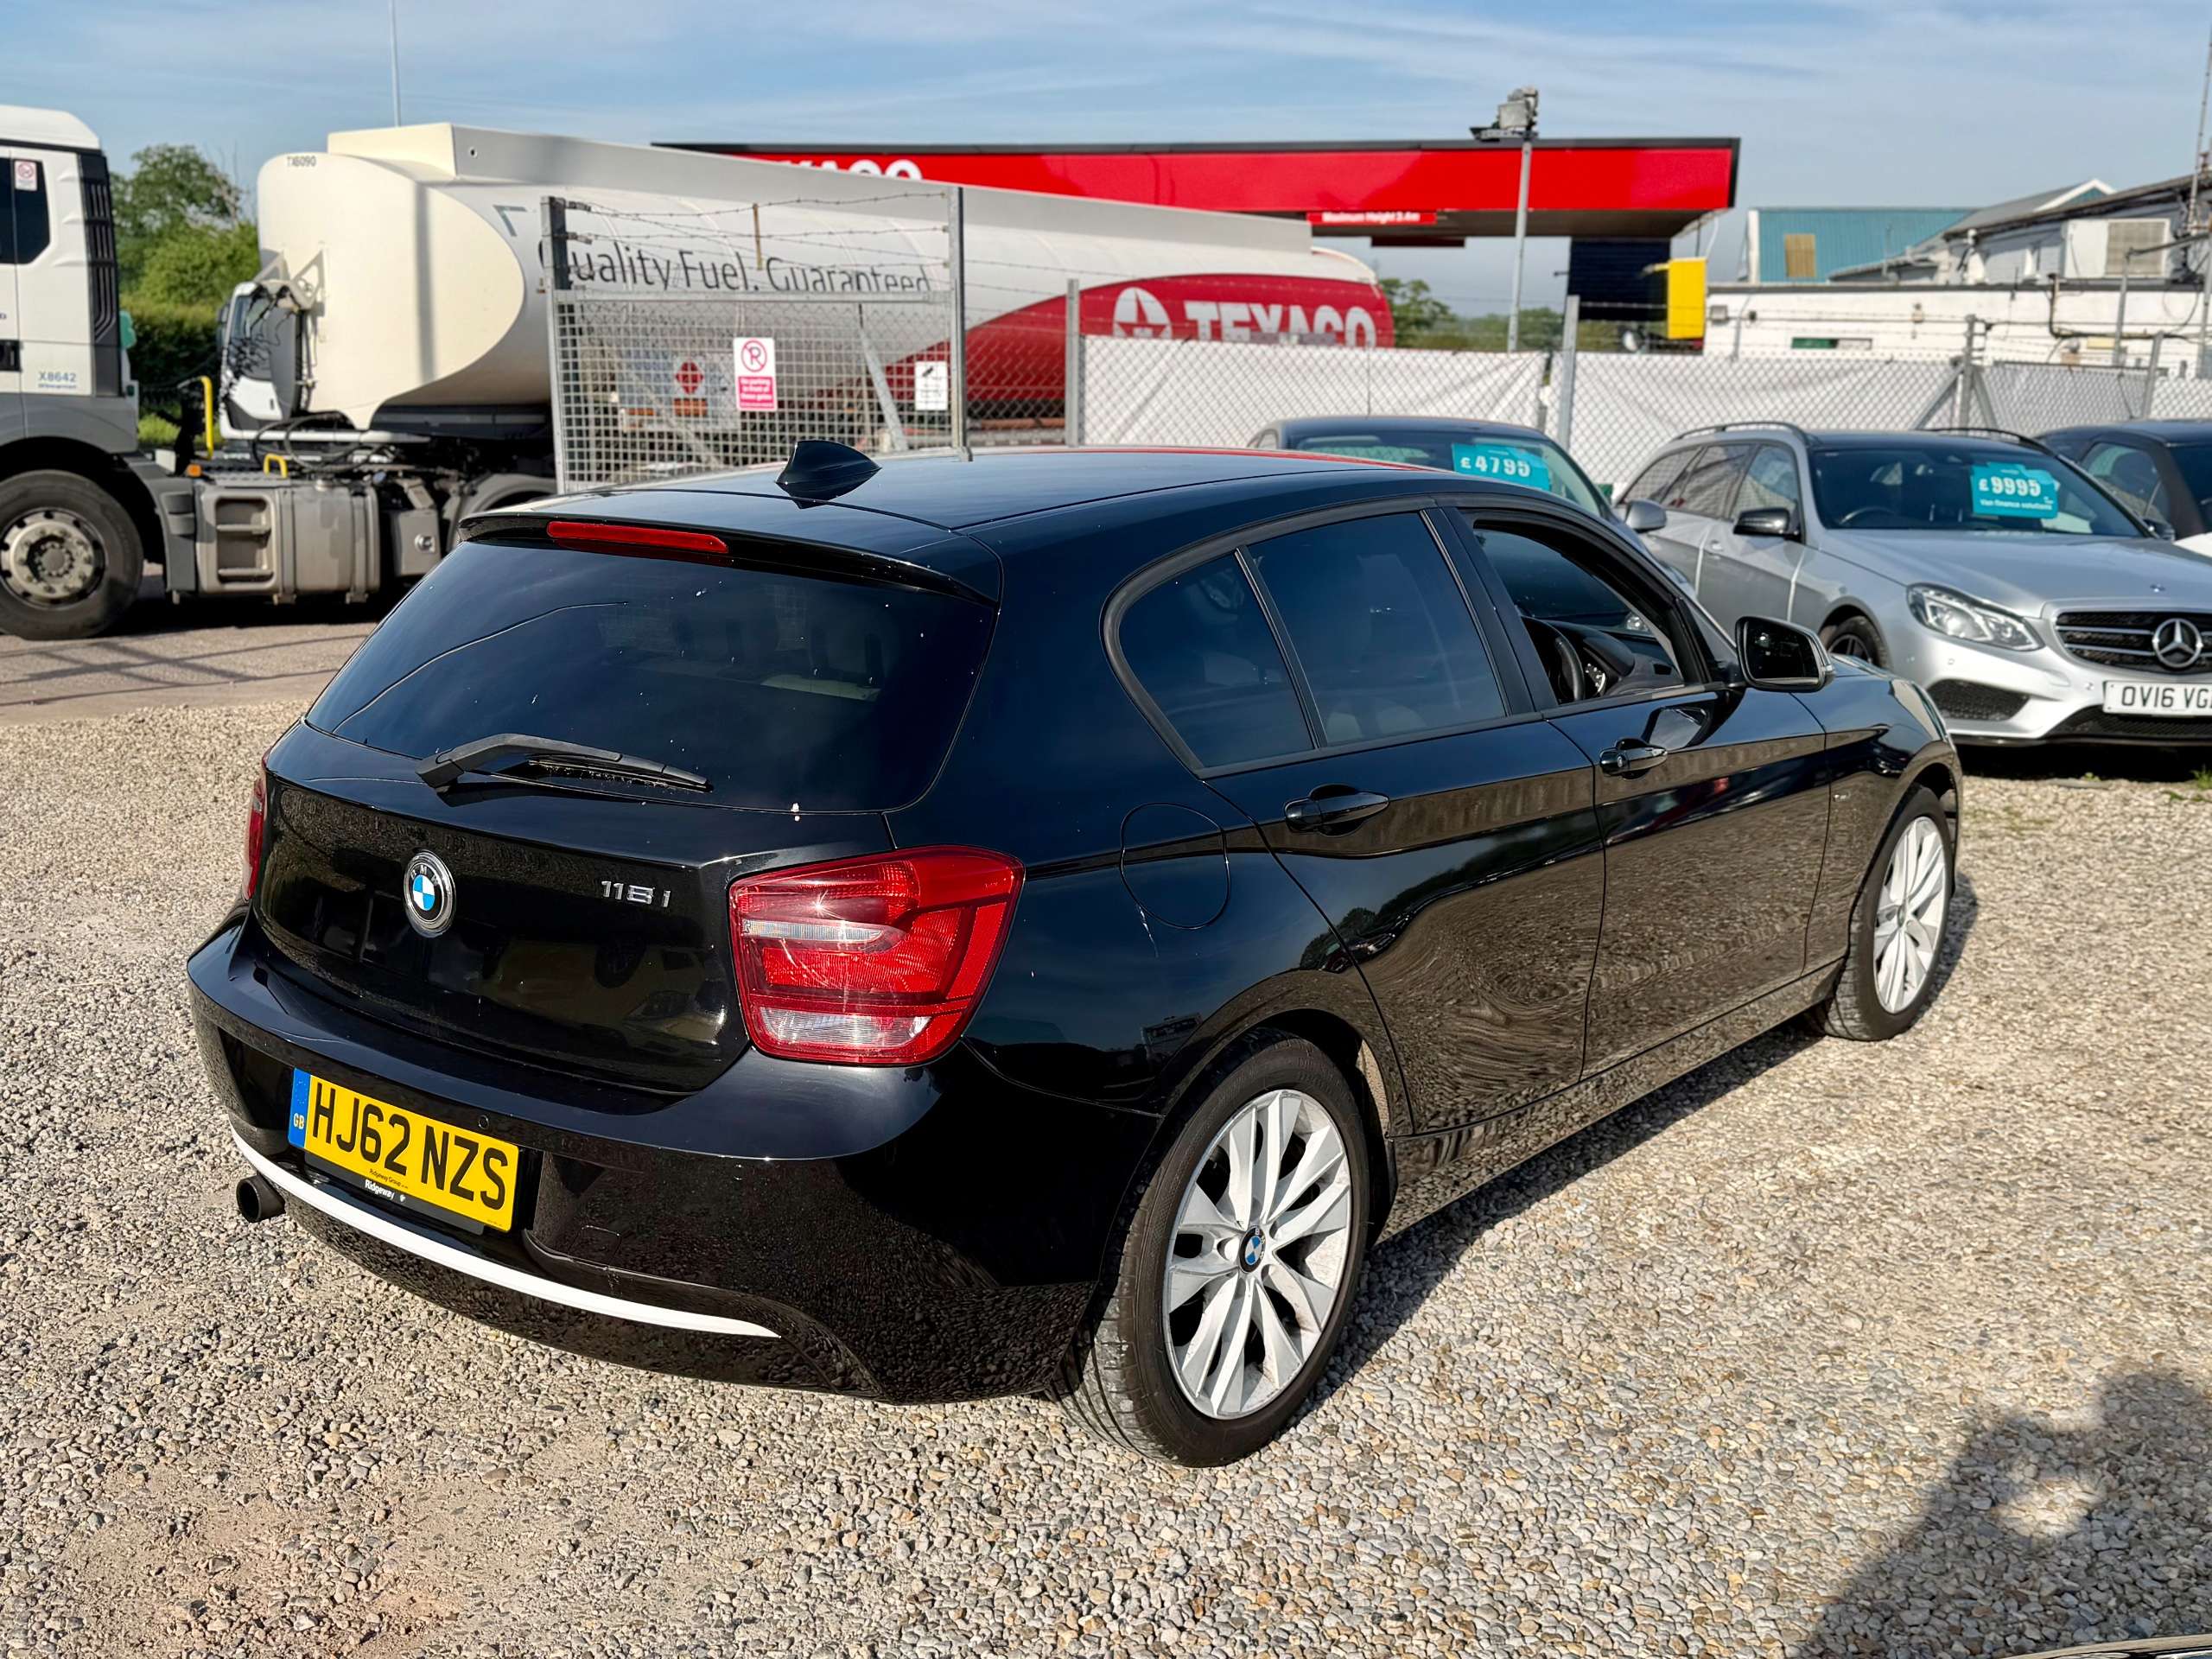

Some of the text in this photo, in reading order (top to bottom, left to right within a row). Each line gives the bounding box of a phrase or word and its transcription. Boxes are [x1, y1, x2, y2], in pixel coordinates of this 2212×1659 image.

[538, 241, 671, 290] uality
[678, 250, 759, 291] Fuel.
[1184, 300, 1376, 346] TEXACO
[39, 372, 77, 382] X8642
[2121, 685, 2212, 709] OV16 VG
[293, 1112, 305, 1130] GB
[312, 1083, 508, 1211] HJ62 NZS
[365, 1179, 395, 1200] Ridgeway
